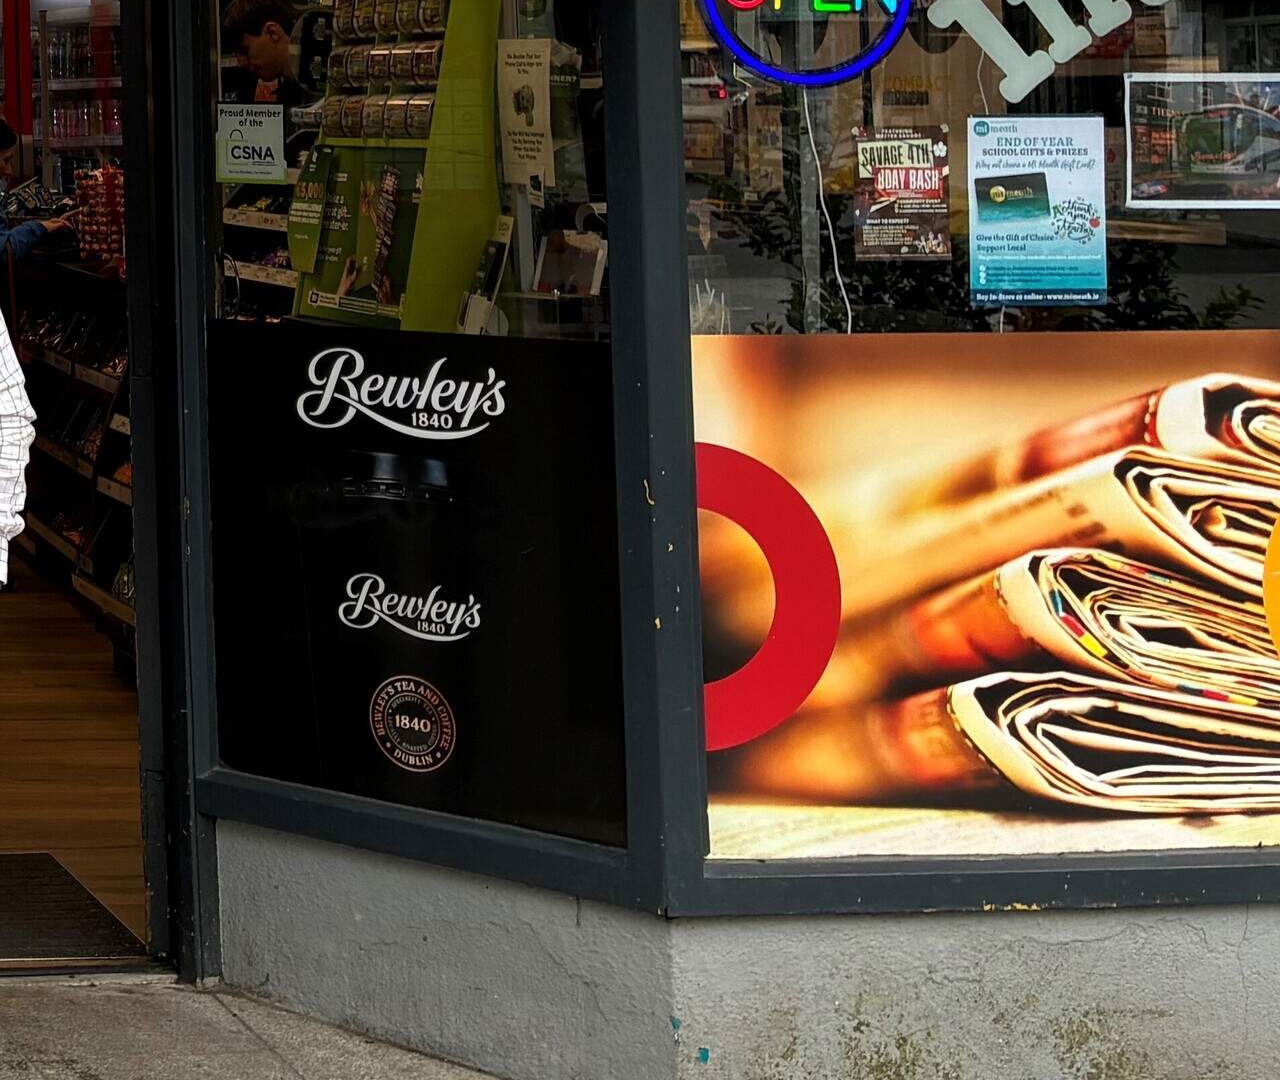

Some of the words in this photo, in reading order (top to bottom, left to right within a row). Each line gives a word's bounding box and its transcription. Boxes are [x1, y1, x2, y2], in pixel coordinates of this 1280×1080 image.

[219, 108, 244, 117] Proud
[246, 109, 281, 118] Member
[238, 118, 248, 127] of
[249, 119, 264, 127] the
[990, 124, 1018, 133] meath
[996, 137, 1022, 147] END
[1024, 137, 1040, 147] OF
[1040, 137, 1074, 147] YEAR
[231, 145, 275, 161] CSNA
[861, 145, 904, 167] SAVAGE
[907, 143, 930, 165] 4TH
[982, 148, 1019, 156] SCHOOL
[1020, 148, 1046, 156] GIFTS
[1046, 148, 1053, 156] &
[1056, 148, 1089, 156] PRIZES
[909, 169, 939, 190] BASH
[976, 244, 1006, 253] Support
[296, 347, 506, 440] Bewley's
[411, 412, 453, 430] 1840
[339, 572, 482, 642] Bewley's
[416, 620, 446, 634] 1840
[394, 681, 416, 692] TEA
[417, 684, 440, 705] AND
[437, 705, 452, 751] COFFEE
[394, 713, 432, 733] 1840
[393, 748, 434, 766] DUBLIN
